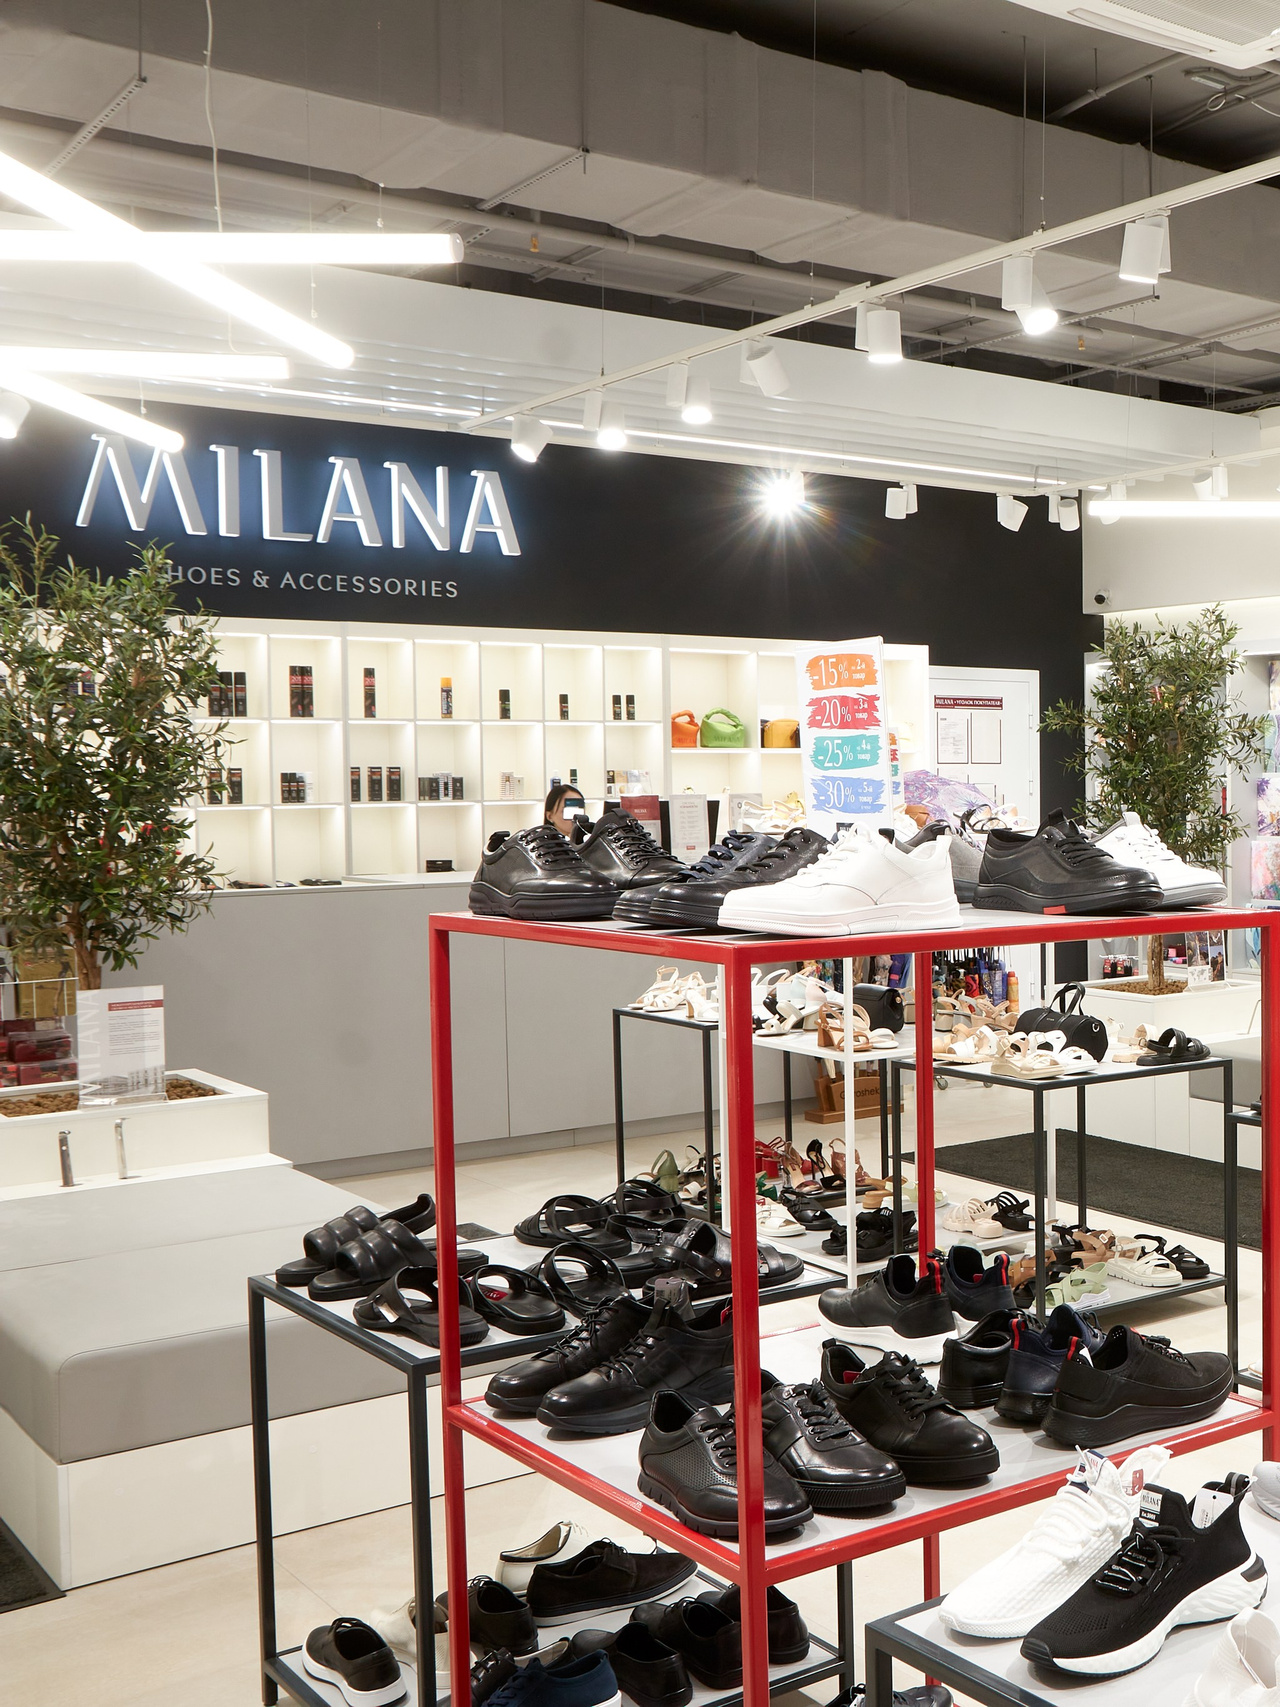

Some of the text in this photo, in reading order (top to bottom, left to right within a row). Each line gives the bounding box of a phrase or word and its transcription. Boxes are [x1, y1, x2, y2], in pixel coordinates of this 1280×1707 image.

[75, 433, 521, 556] MILANA
[160, 565, 458, 598] HOES & ACCESSORIES
[812, 657, 849, 686] -15%
[816, 699, 852, 727] -20%
[818, 739, 853, 767] -25%
[819, 780, 855, 808] -30%
[840, 1087, 880, 1100] Goshek
